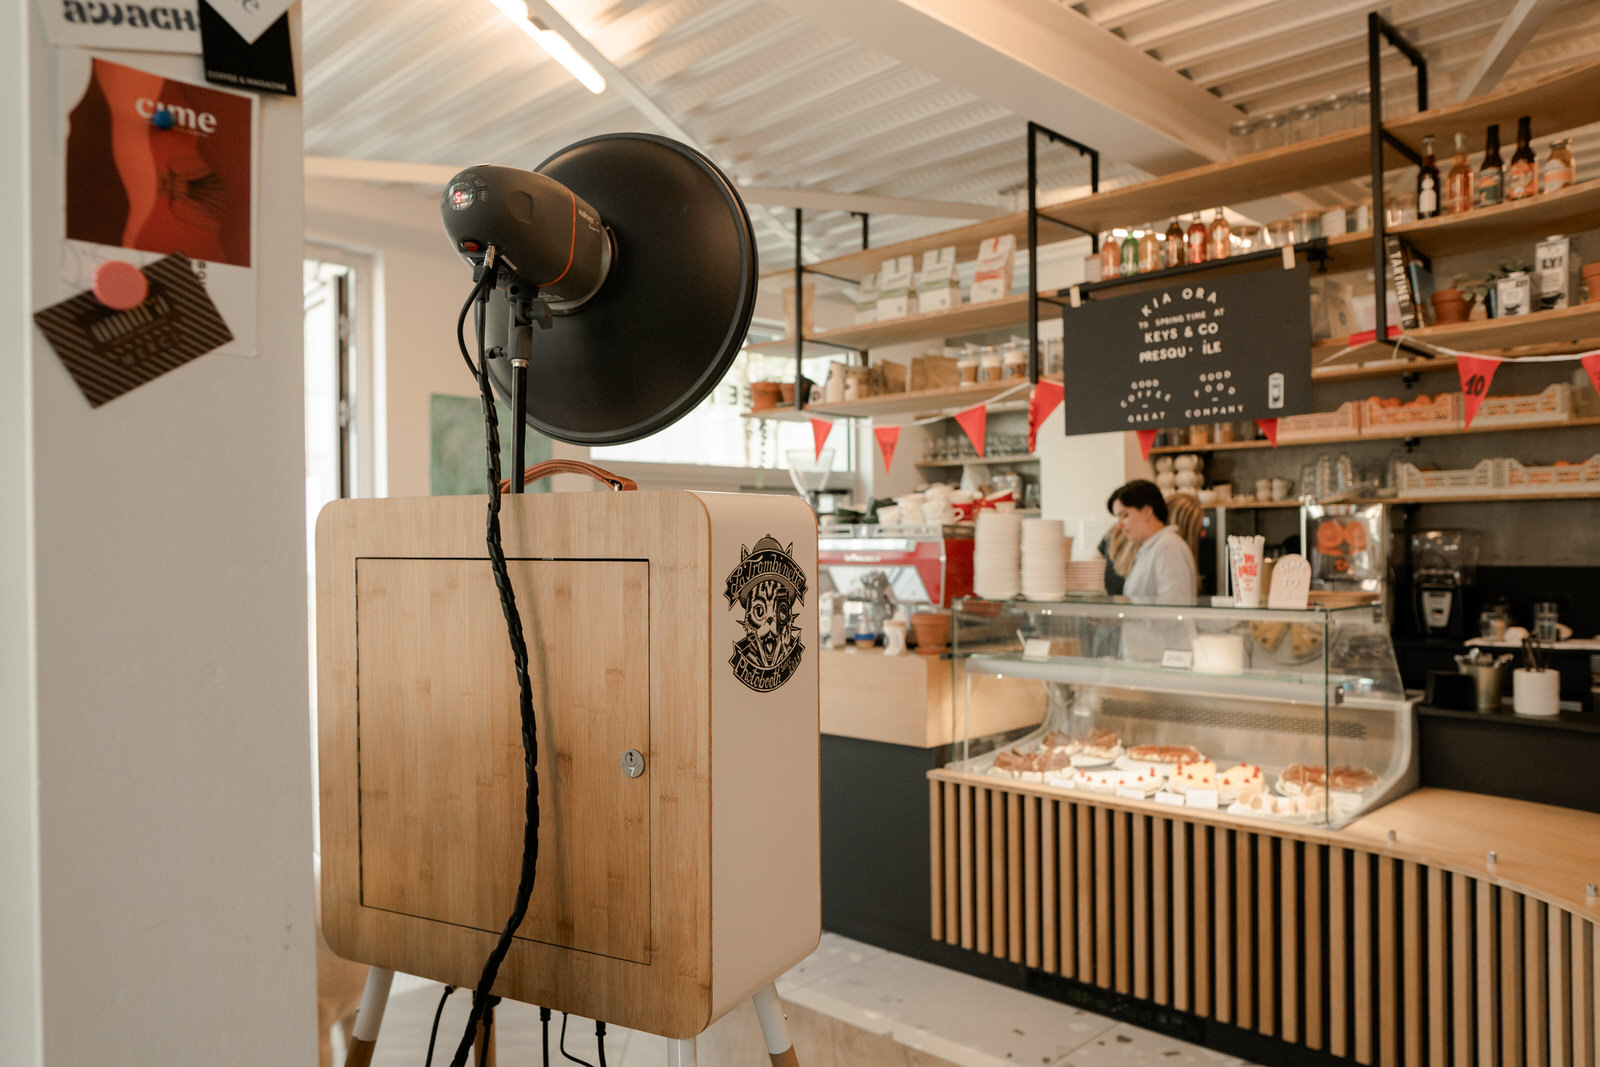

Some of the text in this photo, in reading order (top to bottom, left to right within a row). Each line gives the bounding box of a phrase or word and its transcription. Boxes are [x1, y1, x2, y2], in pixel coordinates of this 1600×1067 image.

[1141, 287, 1217, 317] KIA ORA
[1213, 307, 1225, 317] AT
[1144, 322, 1219, 344] KEYS & CO
[1130, 378, 1160, 390] GOOD
[1198, 369, 1232, 382] GOOD
[1465, 374, 1485, 396] 10
[1120, 389, 1172, 409] COFFEE
[1193, 382, 1236, 398] FOOD
[1127, 404, 1244, 423] GREAT COMPANY
[729, 553, 806, 595] La Trombinette
[735, 655, 782, 689] Photobooth
